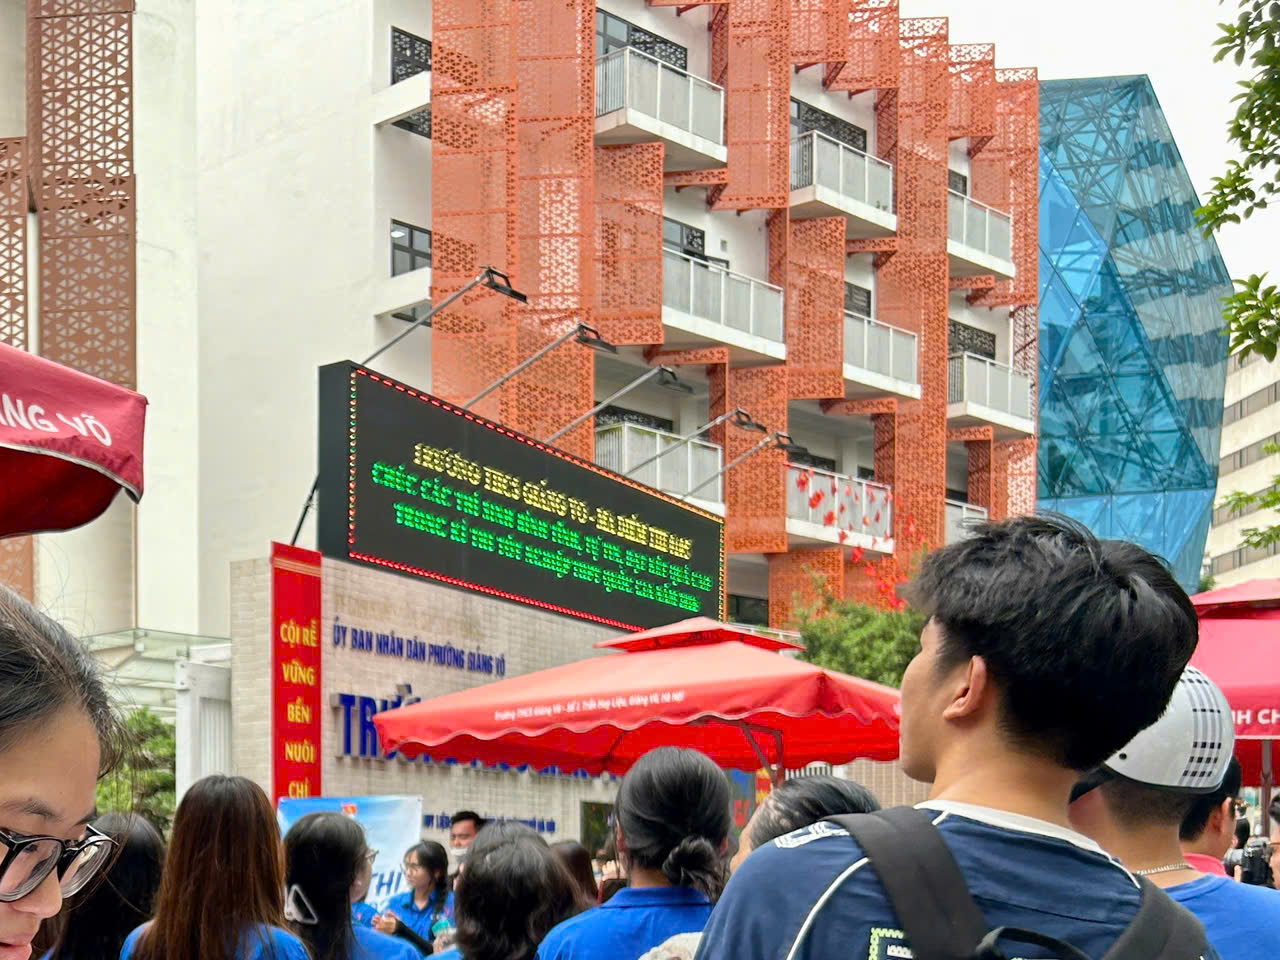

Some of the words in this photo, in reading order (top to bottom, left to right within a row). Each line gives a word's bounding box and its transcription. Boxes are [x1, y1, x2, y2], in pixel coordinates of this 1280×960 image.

[351, 628, 373, 652] BAN
[376, 631, 403, 658] NHÂN
[282, 659, 316, 687] VỮNG
